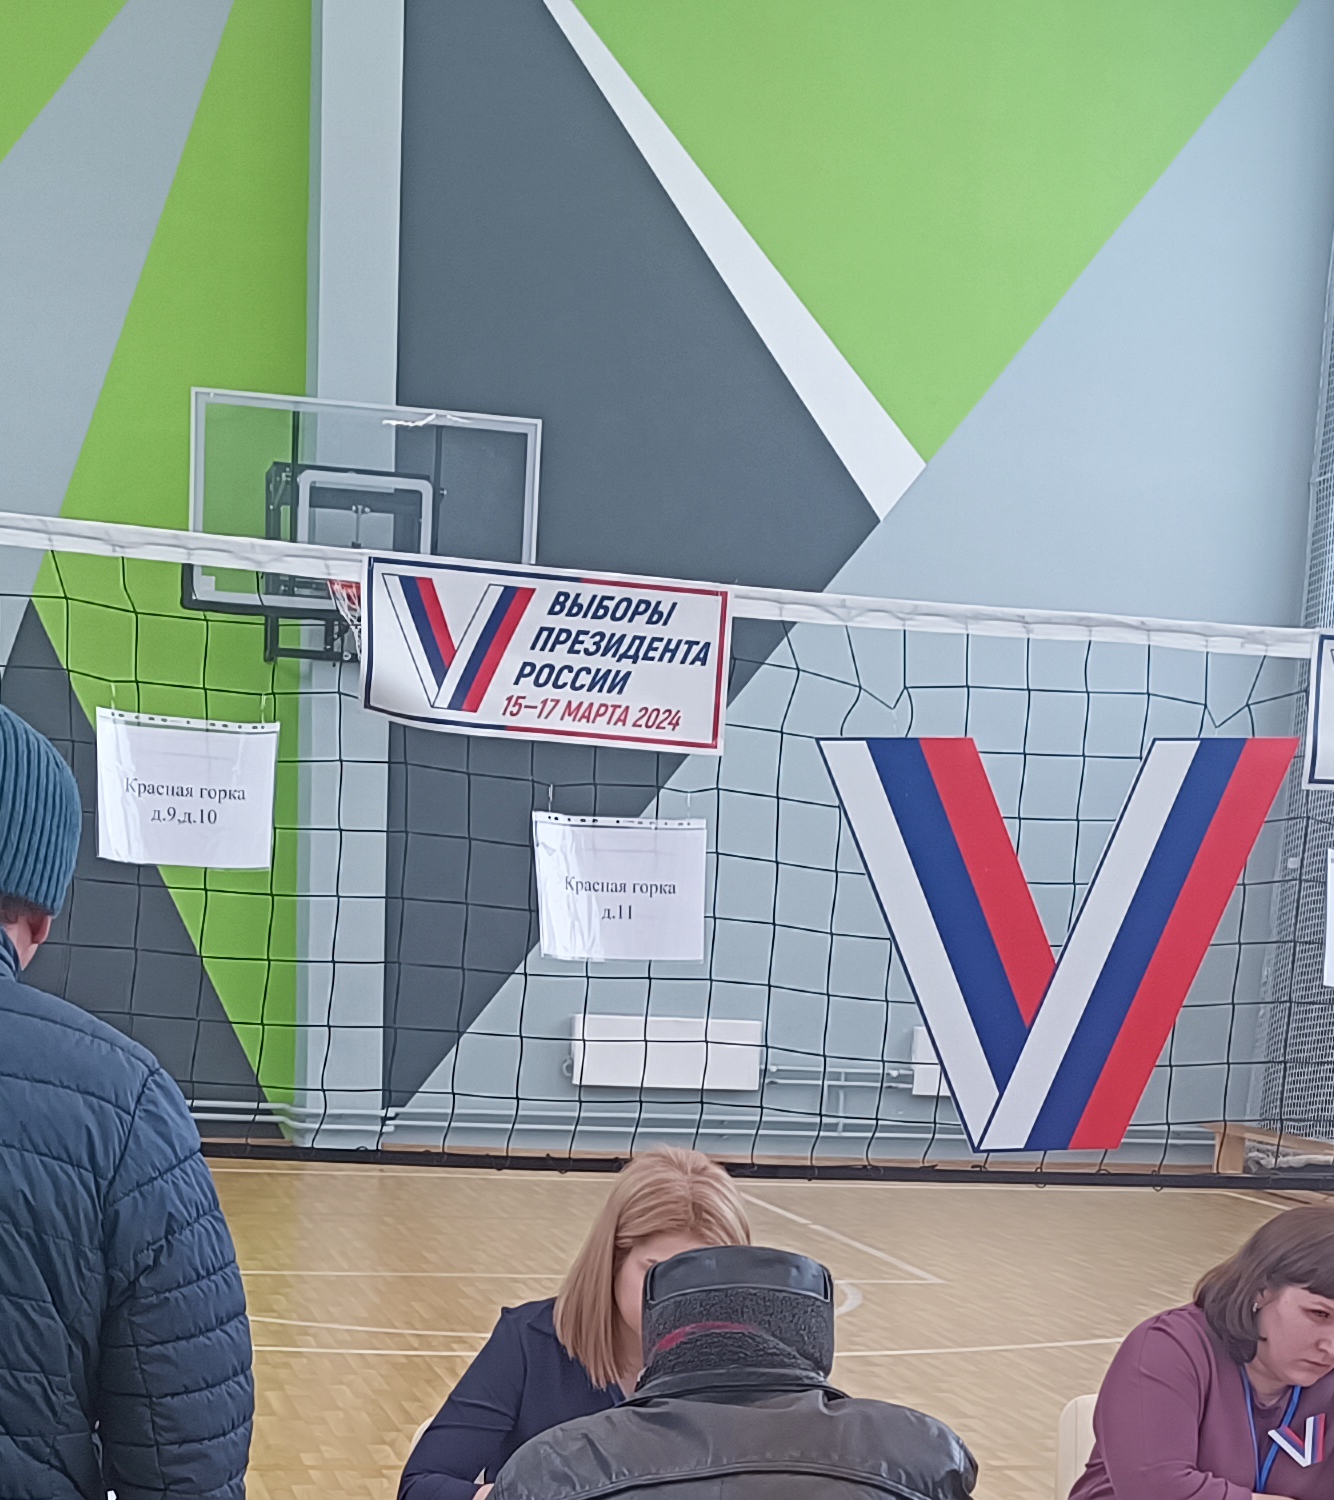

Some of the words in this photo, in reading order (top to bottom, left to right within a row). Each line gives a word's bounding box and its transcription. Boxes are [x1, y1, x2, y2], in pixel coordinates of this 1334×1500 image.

[546, 590, 678, 627] ВЫБОРЫ
[529, 626, 712, 667] ПРЕЗИДЕНТА
[513, 661, 633, 695] РОССИИ
[560, 699, 631, 727] МАРТА
[631, 706, 682, 732] 2024
[125, 777, 194, 798] Красная
[199, 786, 246, 804] горка
[565, 875, 627, 895] Красная
[632, 882, 676, 898] горка
[601, 904, 632, 920] д.11
